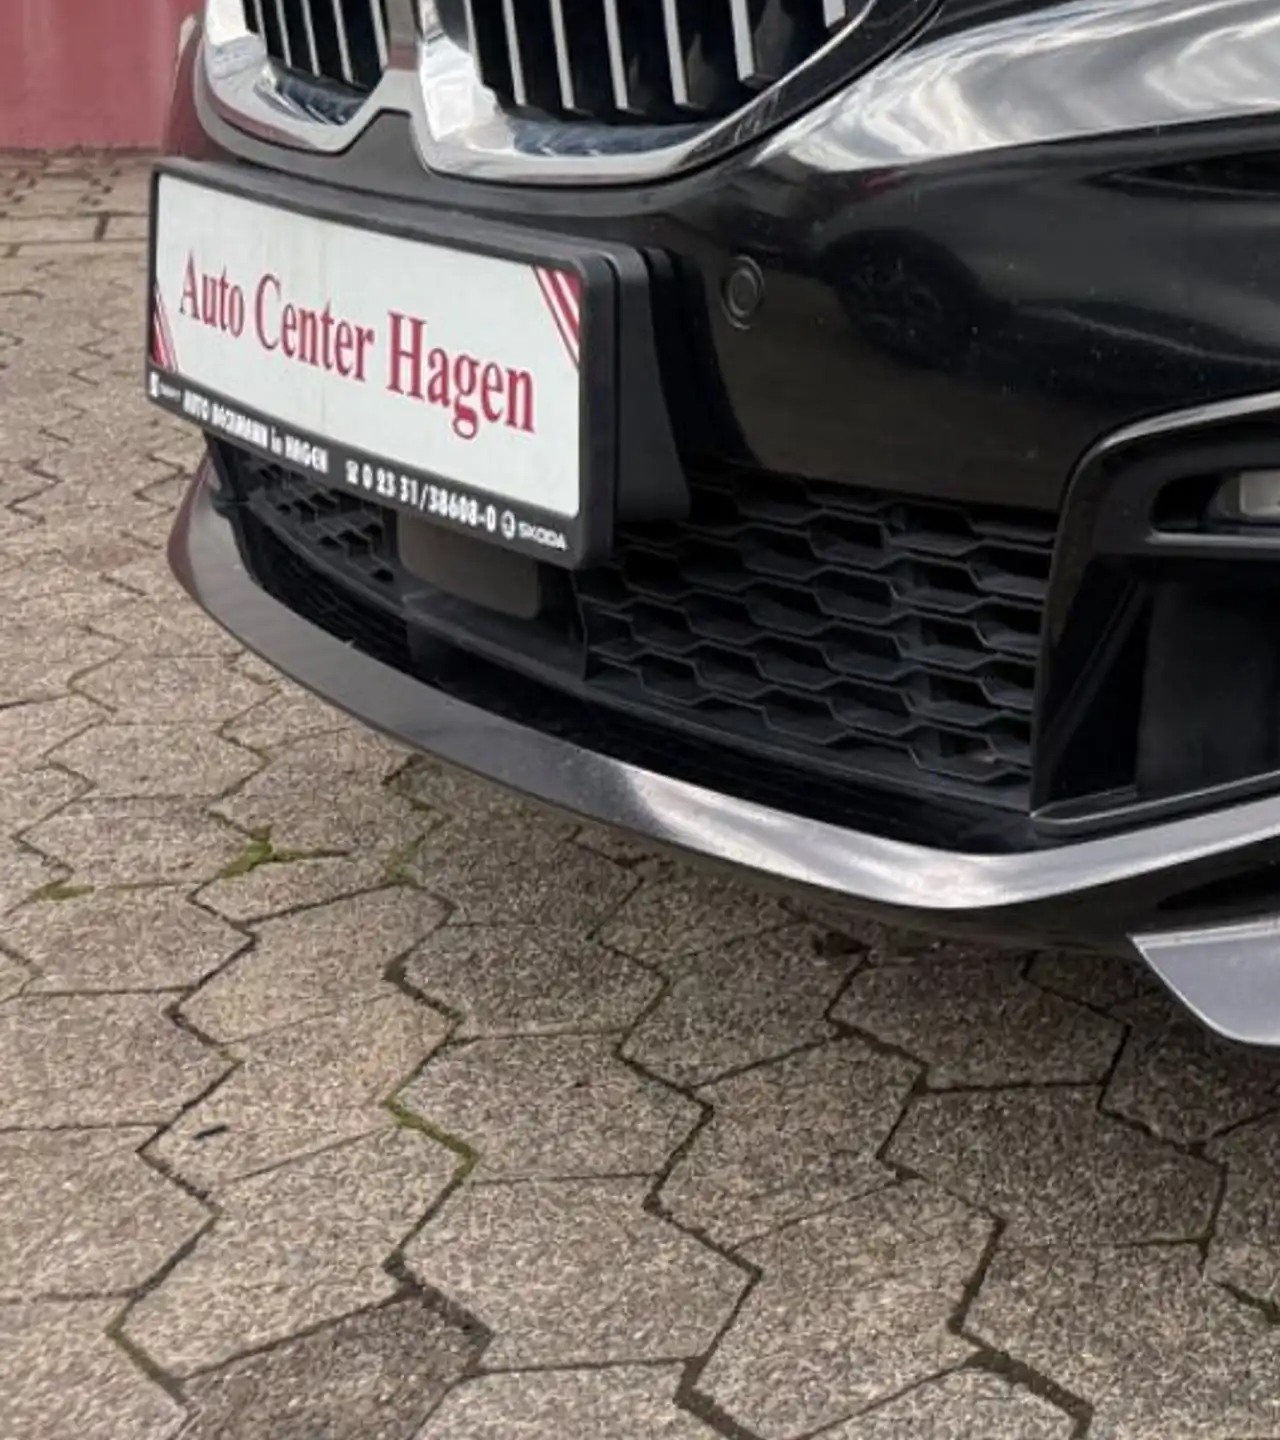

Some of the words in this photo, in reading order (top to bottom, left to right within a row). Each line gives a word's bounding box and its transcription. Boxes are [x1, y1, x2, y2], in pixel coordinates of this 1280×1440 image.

[180, 248, 245, 339] Auto
[254, 273, 375, 383] Center
[386, 309, 535, 440] Hagen
[362, 463, 374, 490] 0
[376, 467, 396, 498] 23
